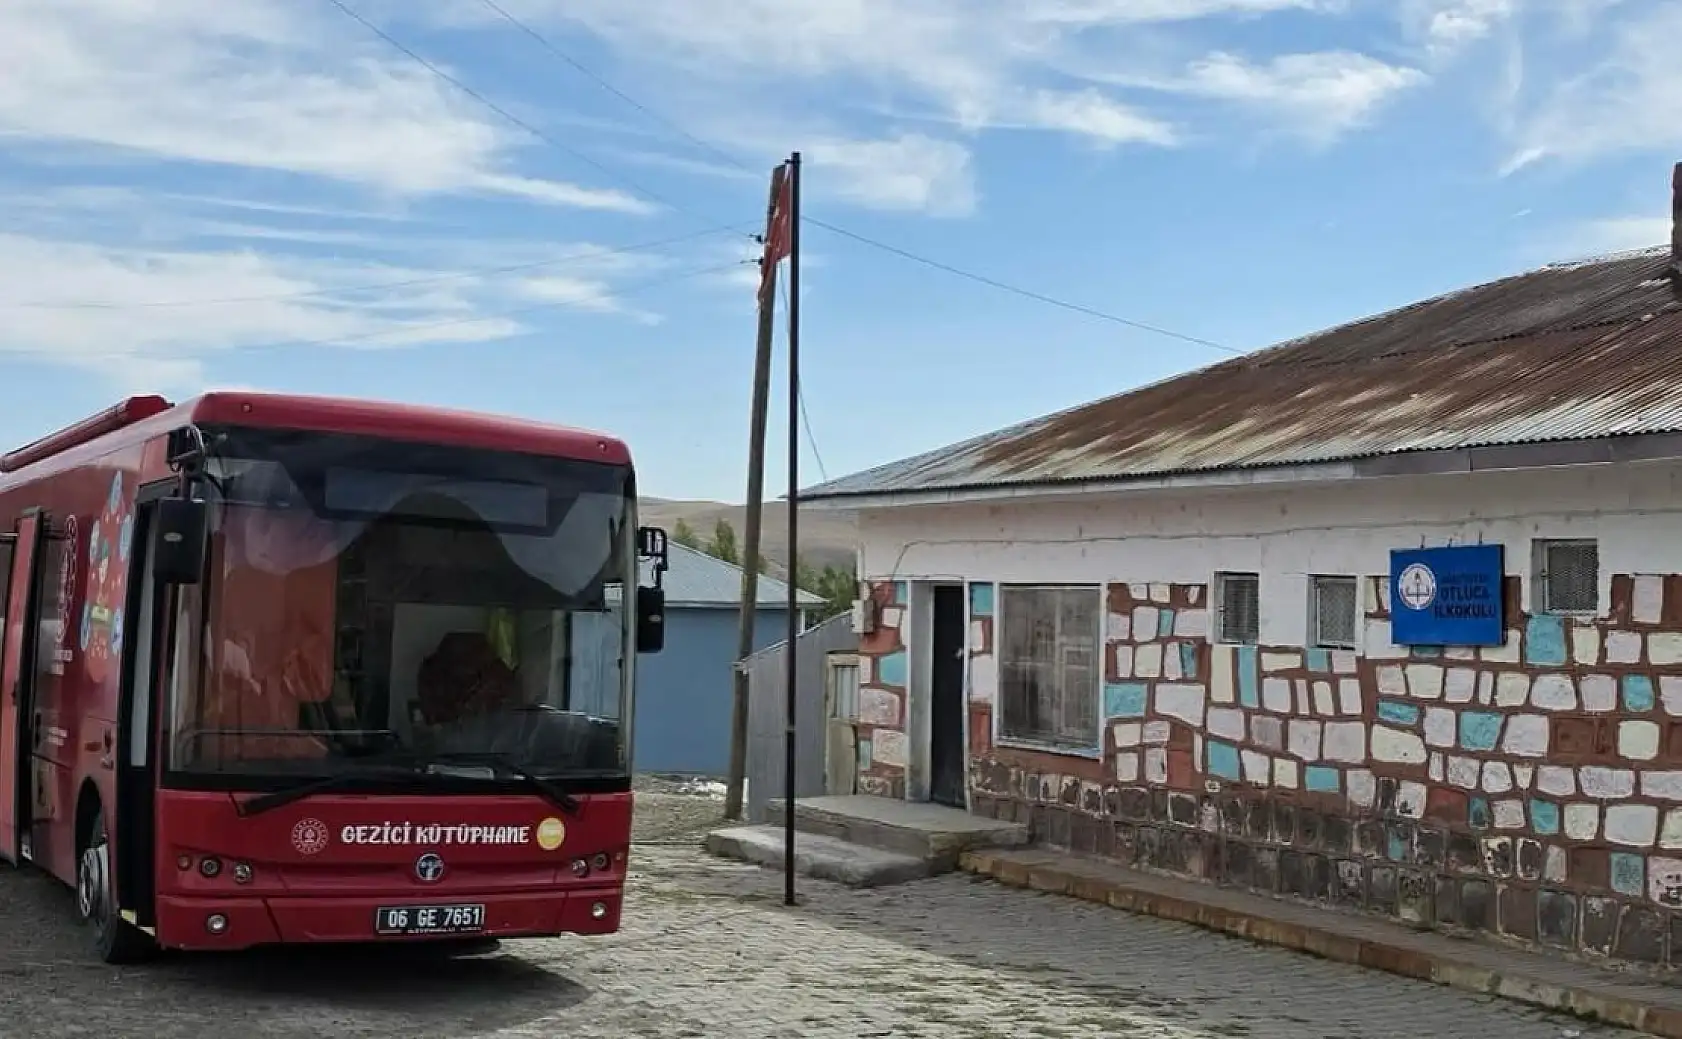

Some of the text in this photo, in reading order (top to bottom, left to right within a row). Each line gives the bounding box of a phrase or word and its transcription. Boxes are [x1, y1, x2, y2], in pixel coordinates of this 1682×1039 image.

[340, 821, 530, 844] GEZİCİ KÜTÜPHANE
[388, 907, 480, 928] 06 GE 7651
